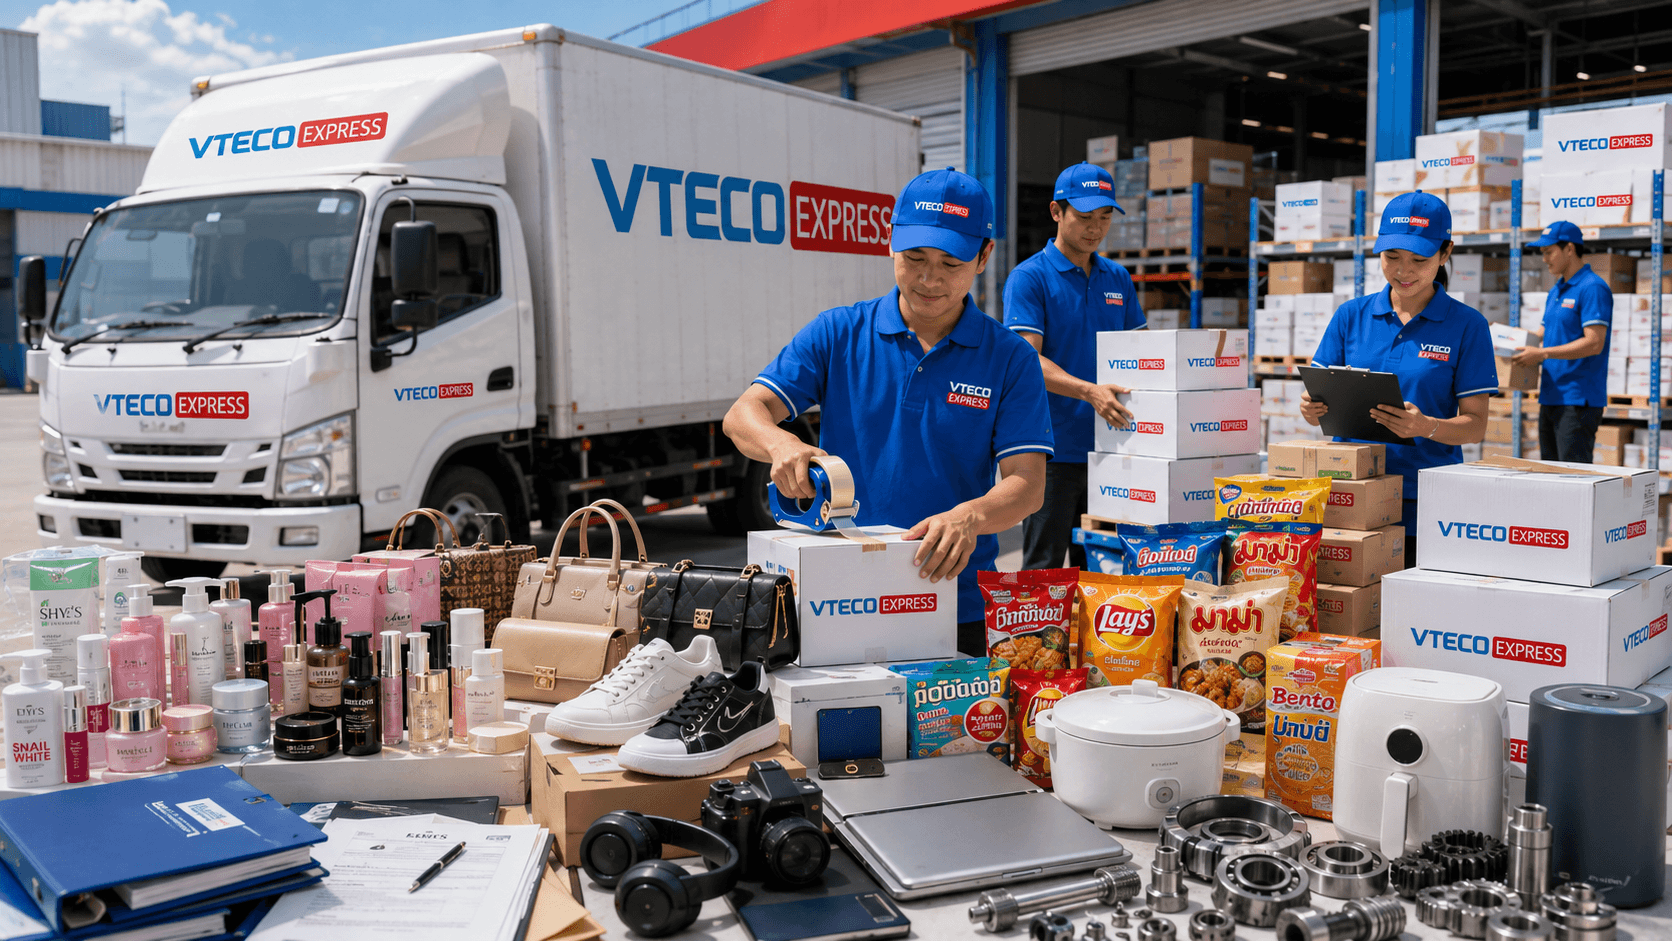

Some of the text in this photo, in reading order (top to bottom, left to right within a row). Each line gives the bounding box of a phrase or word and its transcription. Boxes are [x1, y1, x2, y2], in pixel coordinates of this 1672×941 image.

[189, 117, 383, 158] VTECO EXPRESS
[1558, 135, 1652, 152] VTECO EXPRESS
[1422, 159, 1450, 168] VTECO
[592, 158, 892, 247] VTECO EXPRESS
[914, 201, 943, 212] VTECO
[1283, 199, 1304, 207] VTECO
[1551, 197, 1595, 208] VTECO
[1420, 343, 1451, 354] VTECO
[1108, 360, 1138, 369] VTECO
[1188, 358, 1215, 367] VTECO
[394, 386, 437, 401] VTECO
[950, 381, 991, 398] VTECO
[94, 394, 246, 416] VTECO EXPRESS
[948, 393, 988, 408] EXPRESS
[1190, 422, 1219, 432] VTECO
[1100, 486, 1128, 498] VTECO
[1183, 490, 1214, 501] VTECO
[1438, 520, 1566, 546] VTECO EXPRESS
[1605, 525, 1627, 543] VTECO
[810, 596, 935, 616] VTECO EXPRESS
[1098, 605, 1151, 636] Lay's
[1191, 600, 1262, 634] มาม่า
[1411, 628, 1563, 664] VTECO EXPRESS
[1624, 625, 1650, 653] VTECO
[1272, 687, 1334, 710] Bento
[13, 741, 50, 752] SNAIL
[13, 751, 51, 763] WHITE
